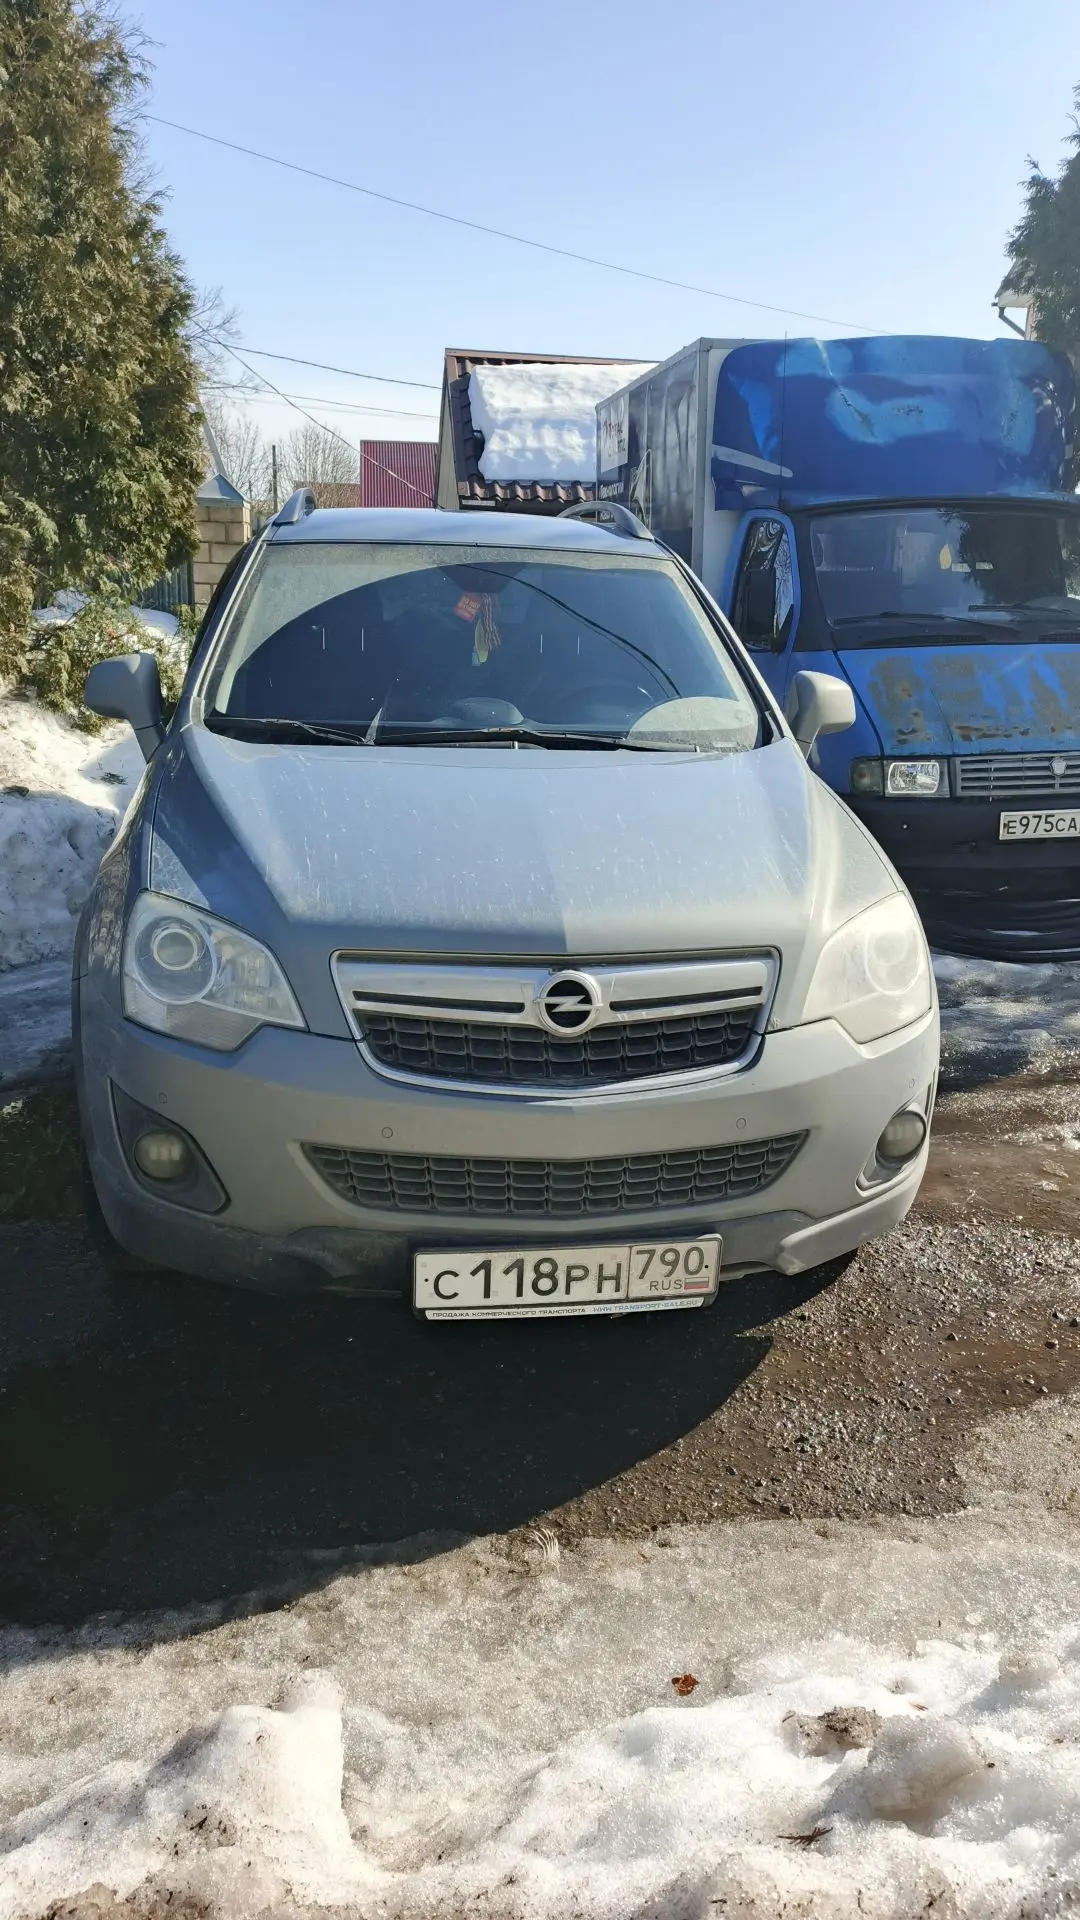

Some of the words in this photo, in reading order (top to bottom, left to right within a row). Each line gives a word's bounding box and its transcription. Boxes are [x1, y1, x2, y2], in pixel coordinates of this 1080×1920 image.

[433, 1257, 622, 1300] С118РН
[636, 1246, 704, 1280] 790
[649, 1279, 683, 1292] RUS
[472, 1310, 537, 1318] КОММЕРЧЕСКОГО
[539, 1308, 586, 1316] ТРАНСПОРТА
